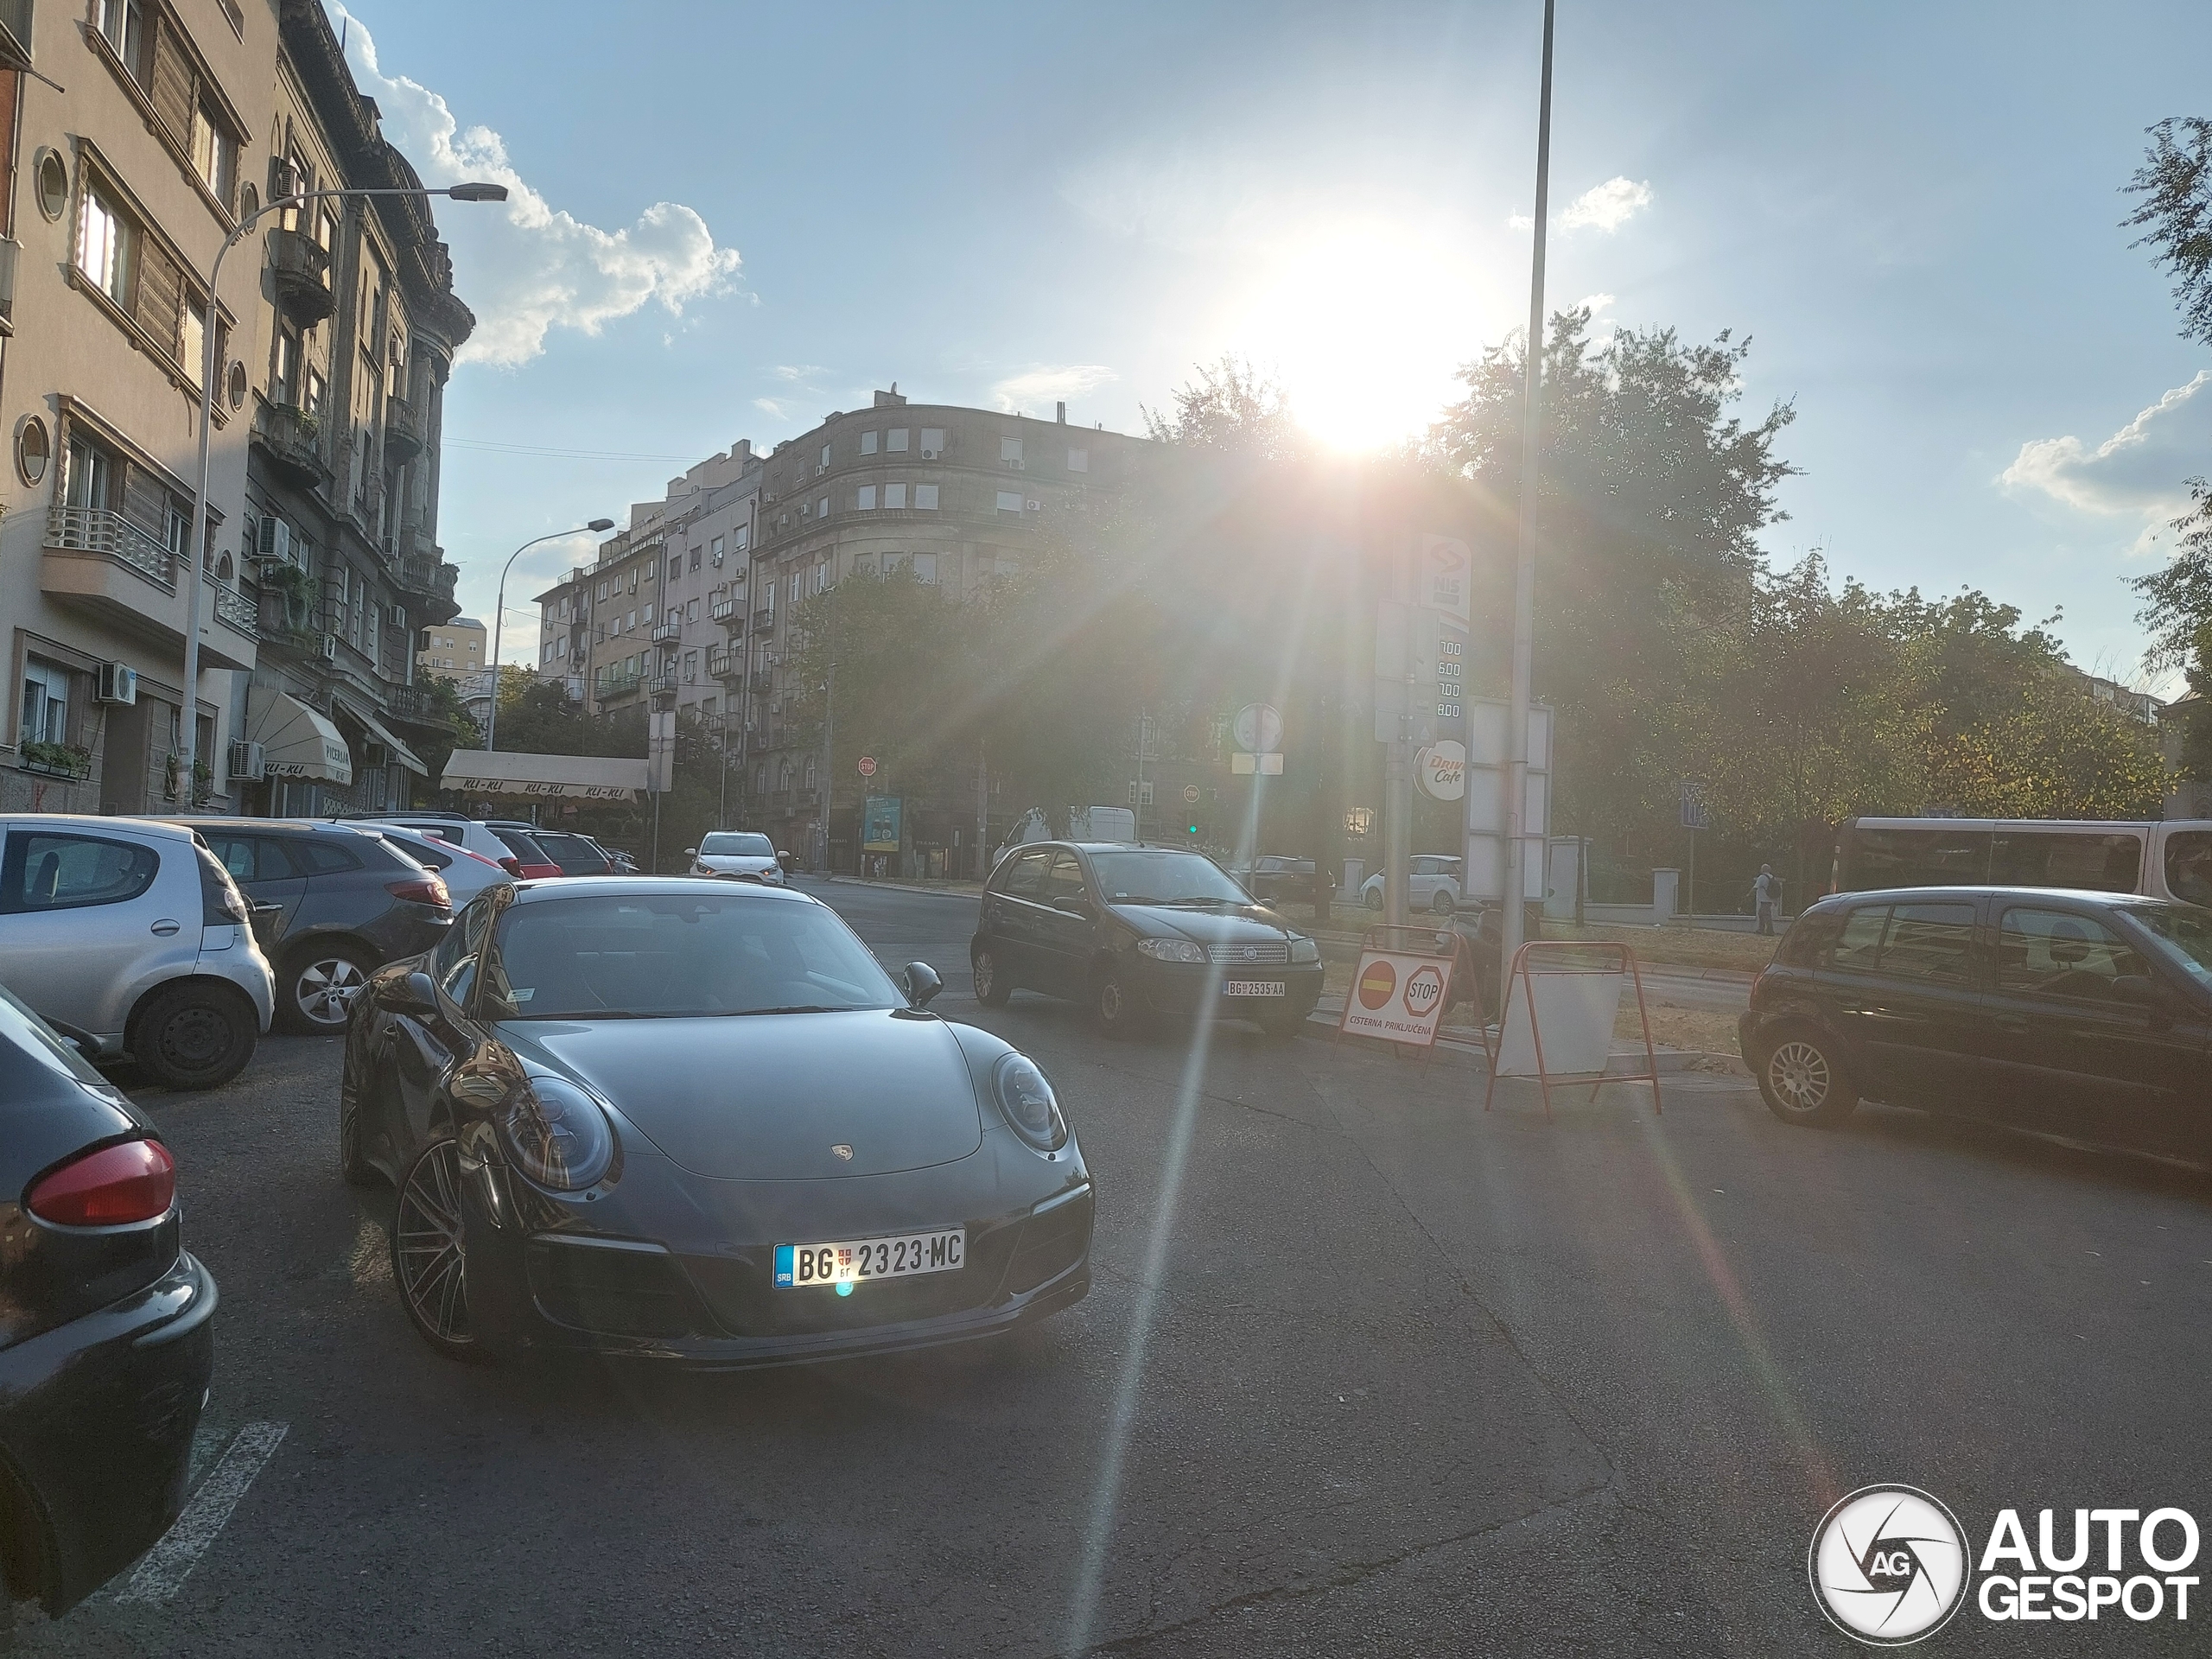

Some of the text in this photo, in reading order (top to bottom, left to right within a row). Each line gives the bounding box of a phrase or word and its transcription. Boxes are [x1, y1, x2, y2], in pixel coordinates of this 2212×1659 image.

[1433, 575, 1460, 594] NIS
[1435, 769, 1461, 784] Cafe
[1230, 982, 1242, 995] BG
[1409, 982, 1438, 1000] STOP
[1350, 1015, 1431, 1035] CISTERNA PRIKLJUČENA
[798, 1248, 834, 1281] BG
[777, 1273, 791, 1282] SRB
